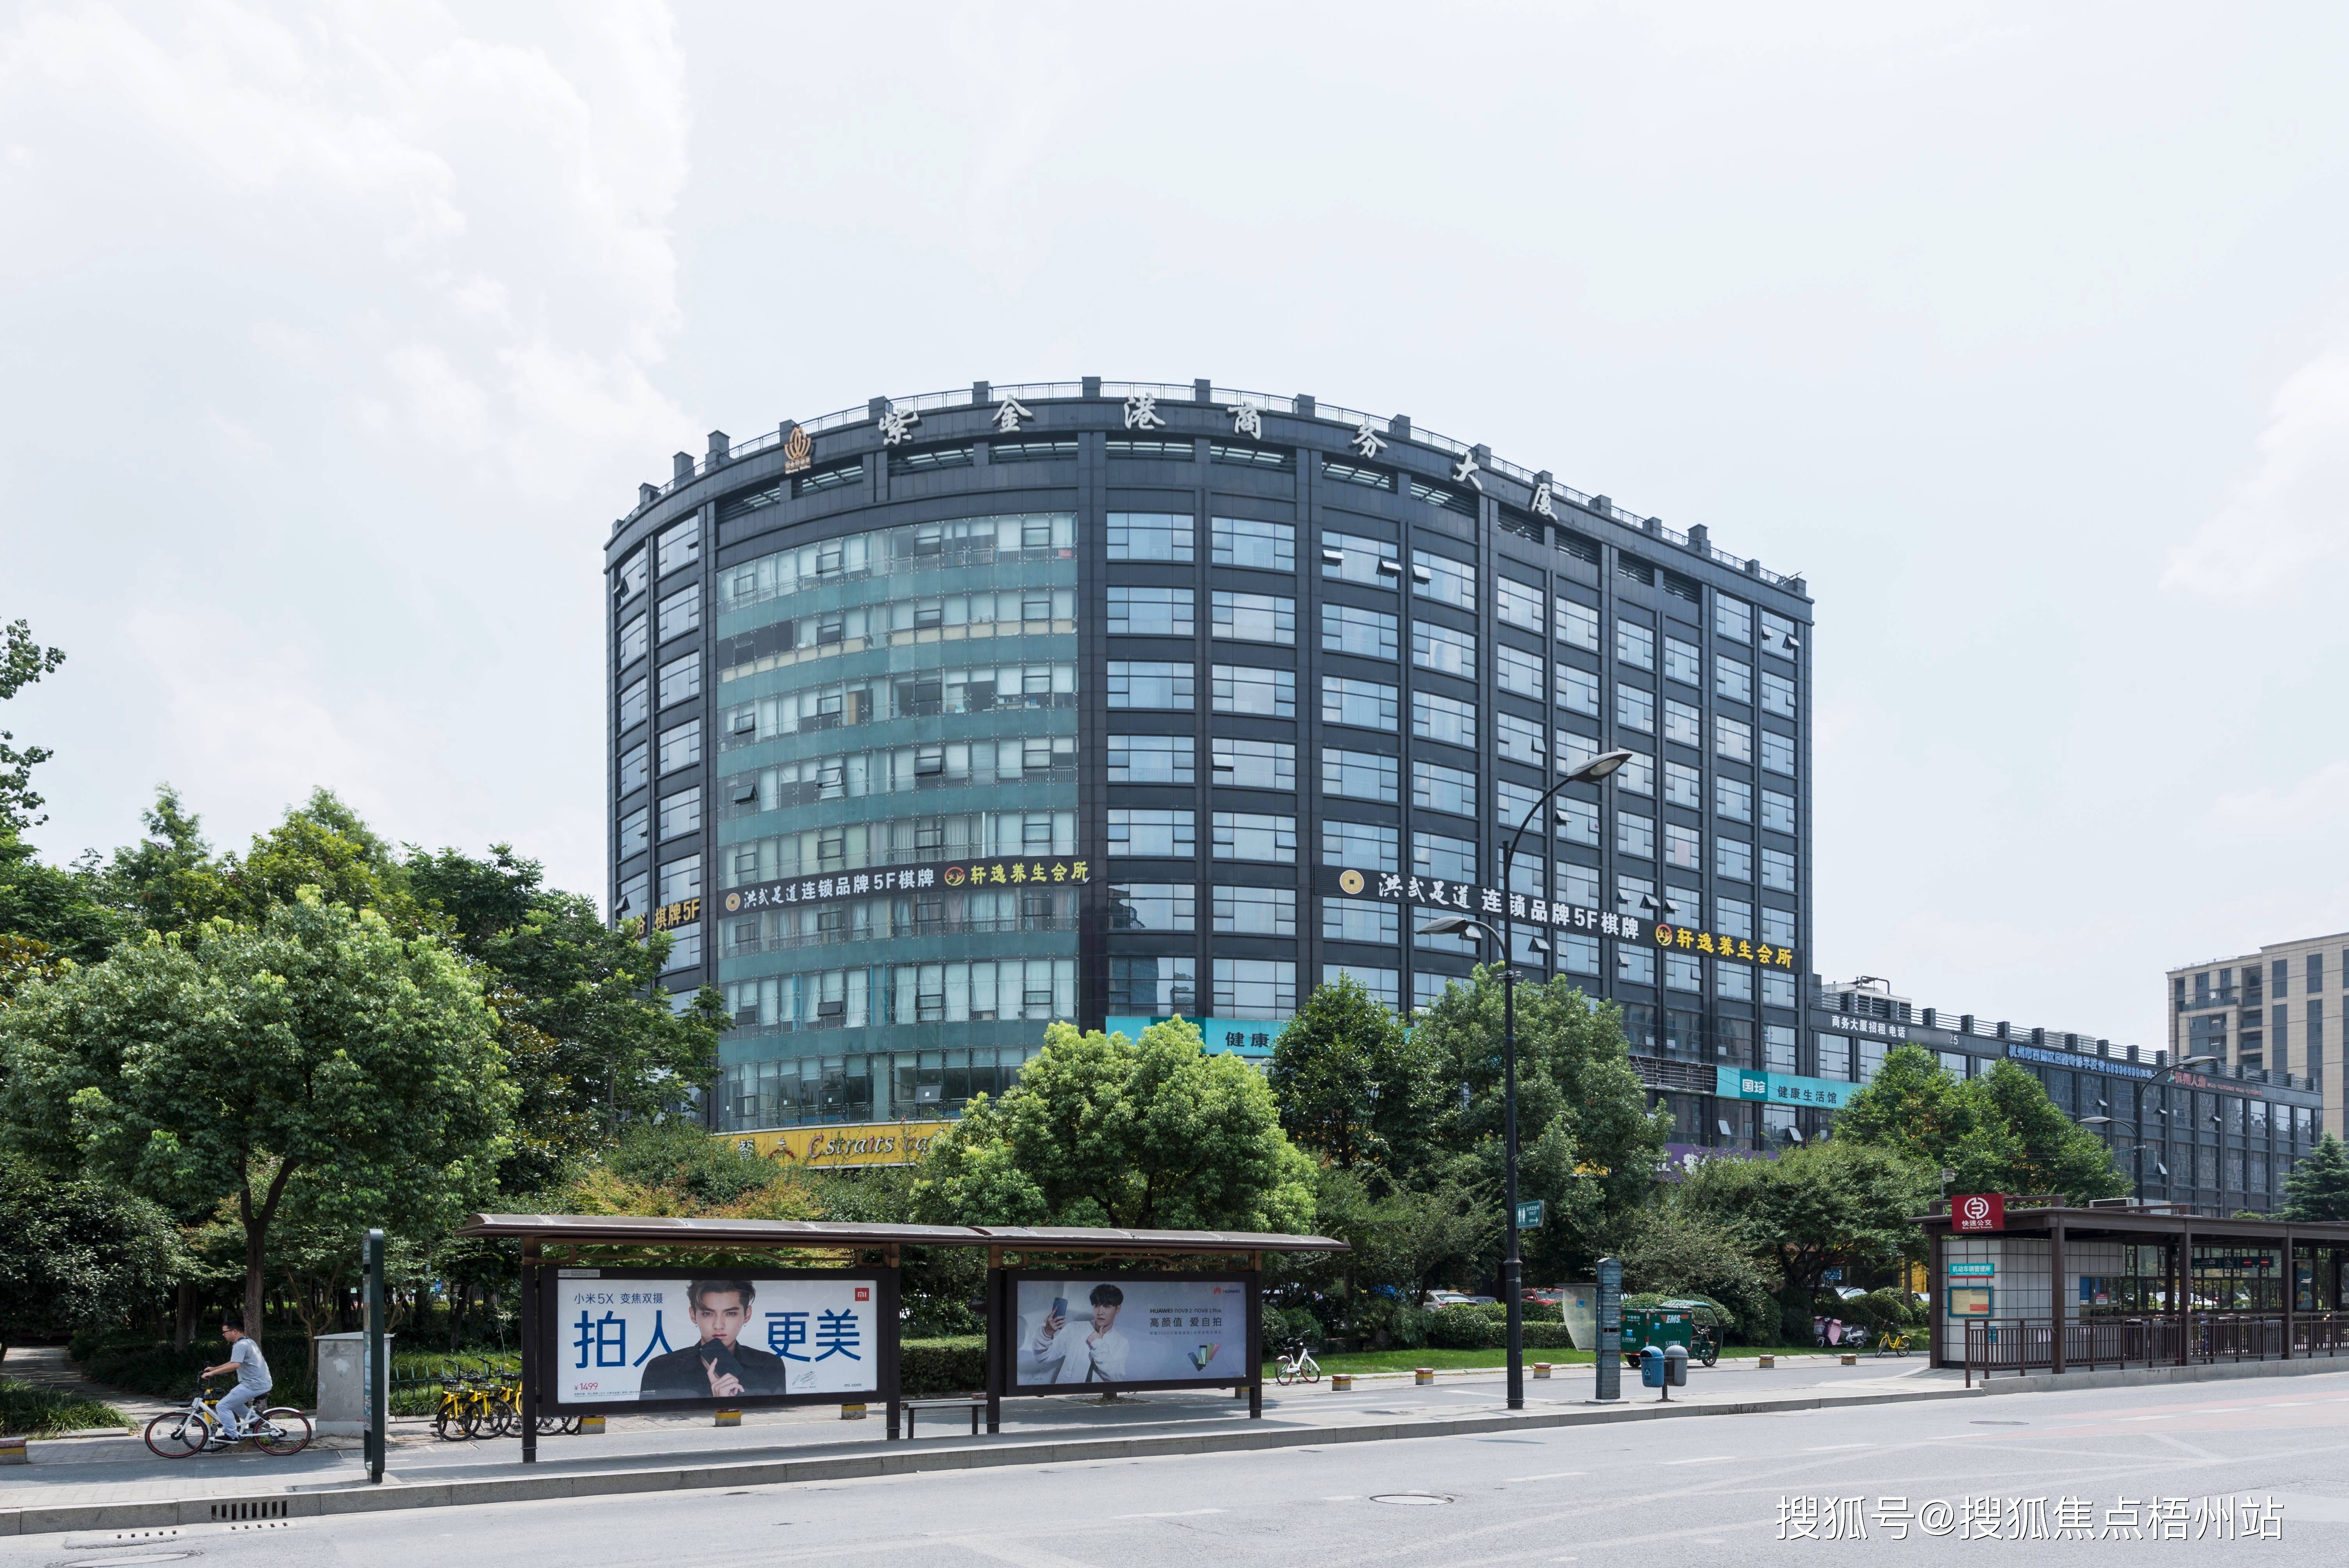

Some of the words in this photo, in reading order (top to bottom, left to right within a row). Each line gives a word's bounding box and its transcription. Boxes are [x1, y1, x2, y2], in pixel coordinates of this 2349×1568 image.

[970, 861, 1089, 885] 轩逸养生会所
[654, 898, 700, 929] 棋牌5F
[1676, 927, 1793, 968] 轩逸养生会所
[1832, 1015, 1886, 1035] 商务大厦招租
[1889, 1025, 1906, 1039] 电话
[1225, 1032, 1270, 1048] 健康
[1742, 1079, 1766, 1093] 国珍
[1777, 1085, 1837, 1104] 健康生活馆
[574, 1293, 613, 1304] 小米5X
[620, 1293, 663, 1304] 变焦双摄
[1150, 1317, 1182, 1327] 高颜值
[1190, 1317, 1221, 1327] 爱自拍
[1666, 1315, 1681, 1324] EMS
[574, 1310, 672, 1368] 拍人
[765, 1309, 861, 1362] 更美
